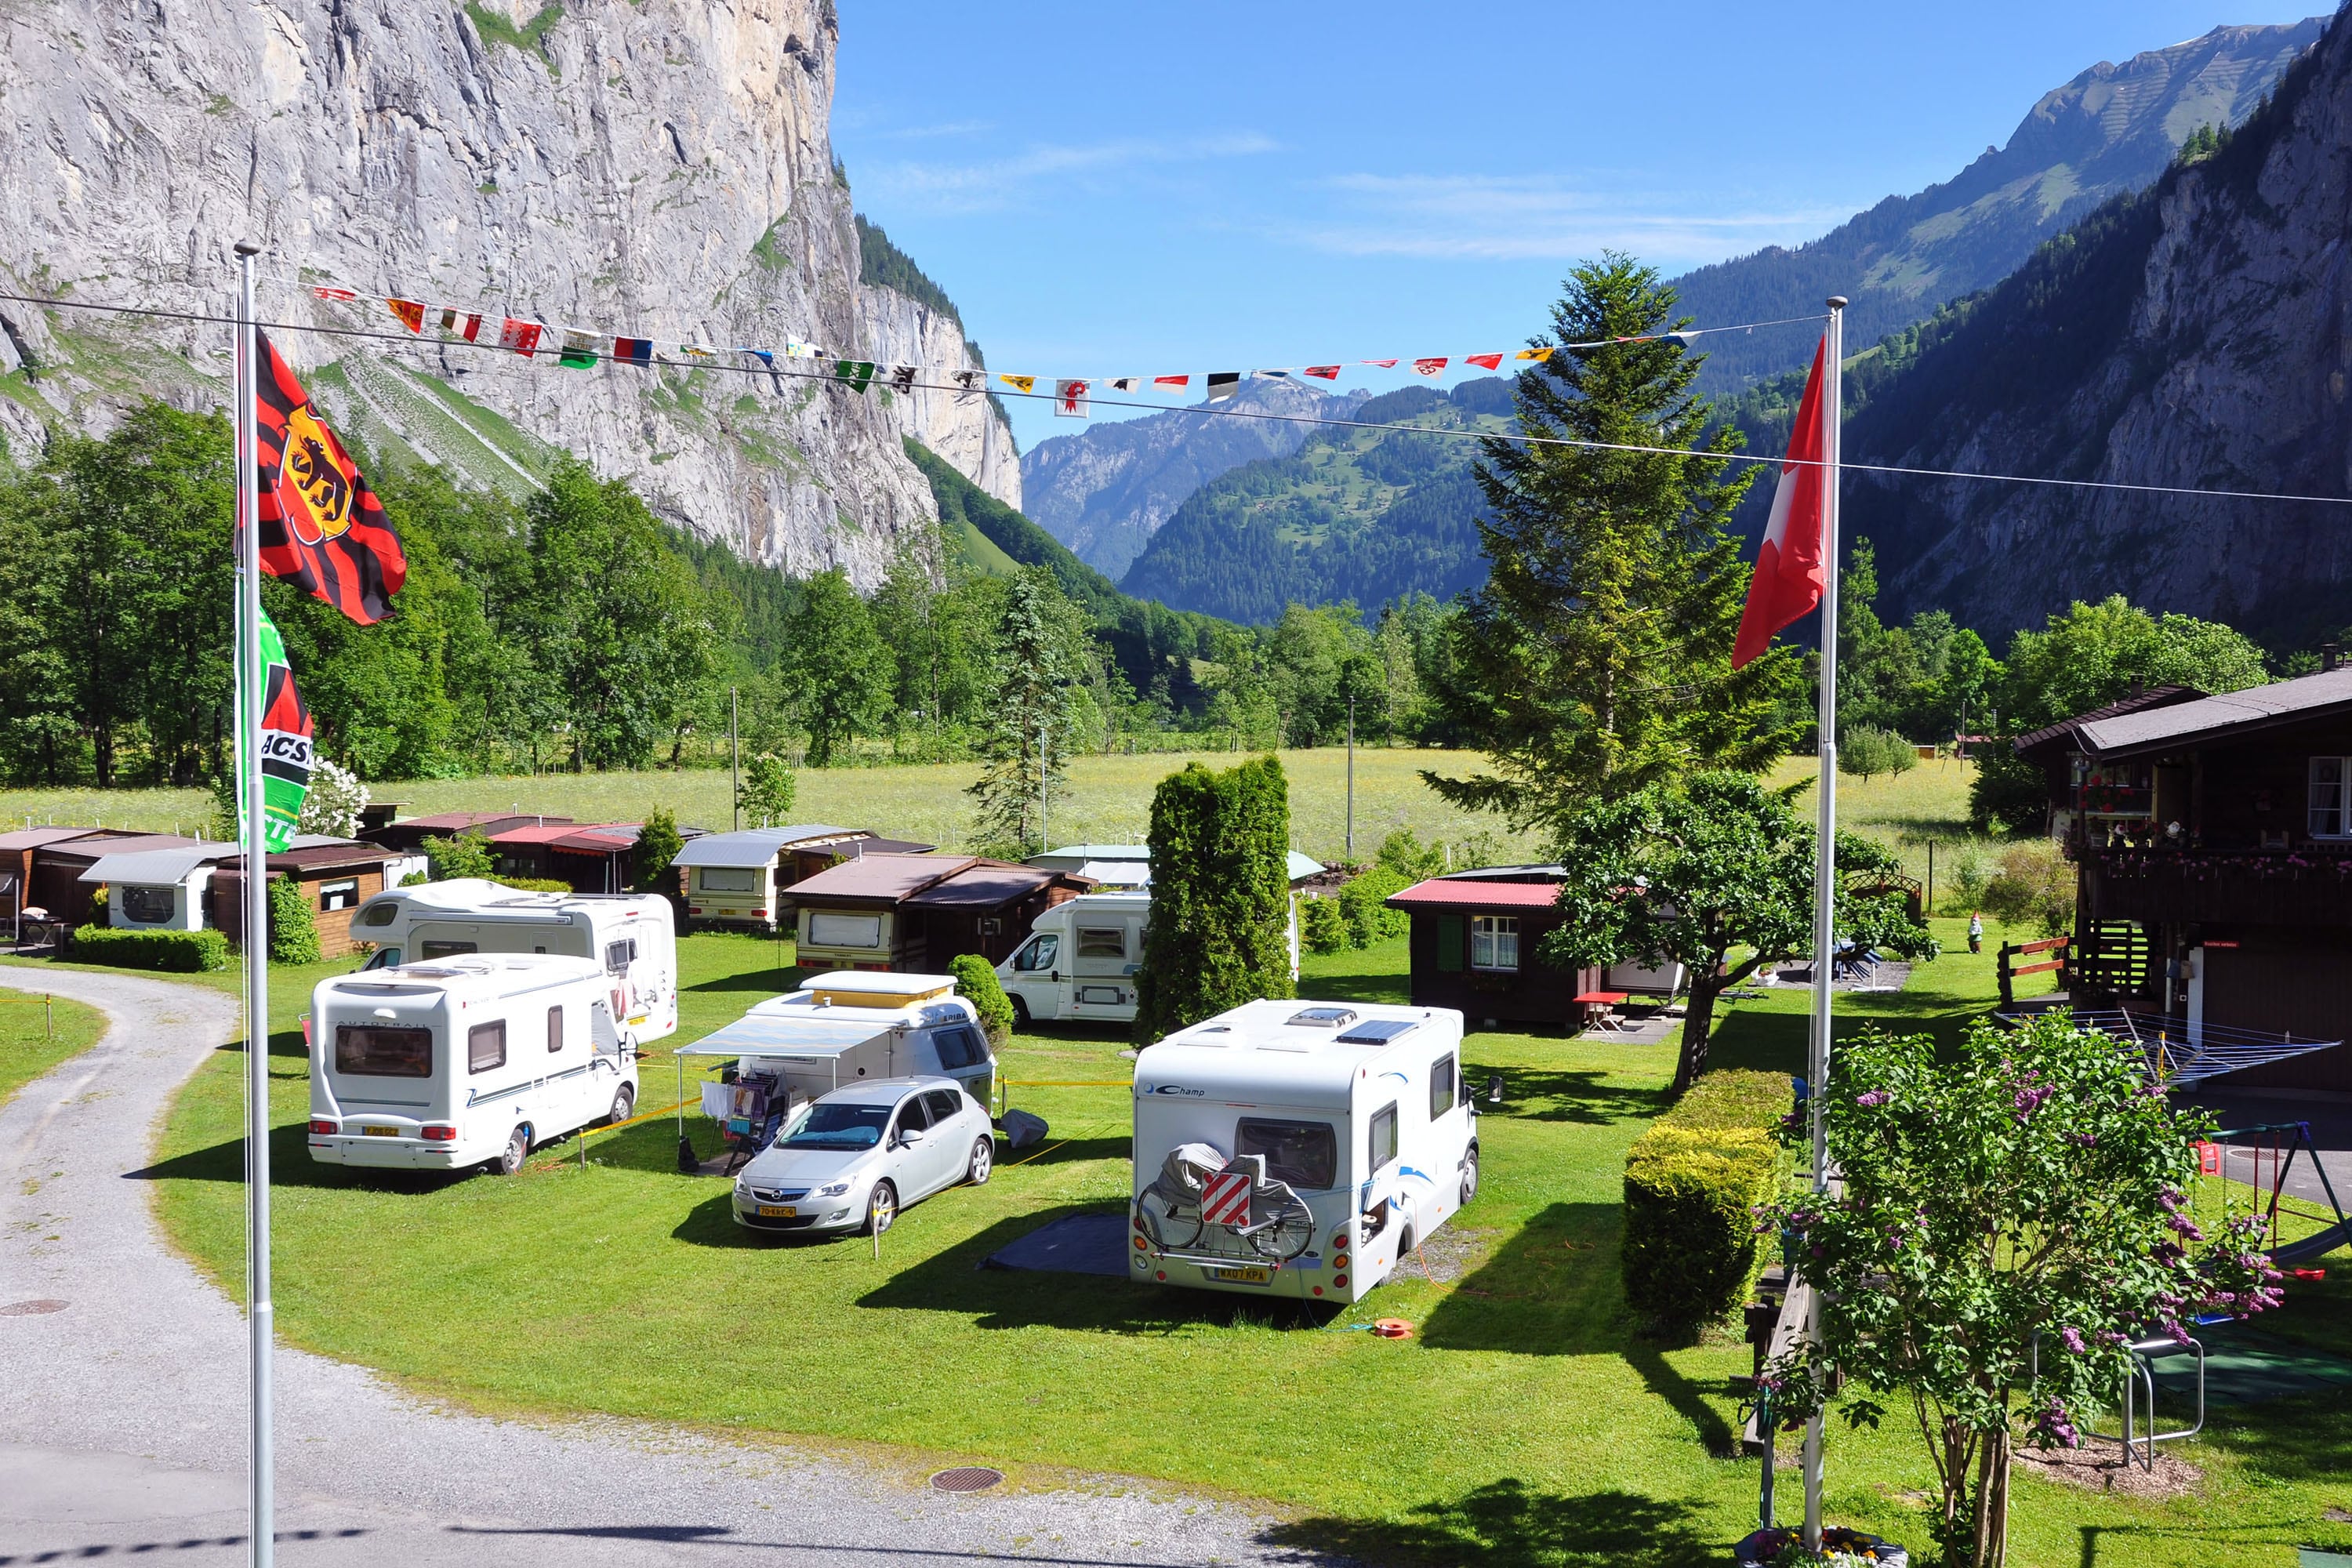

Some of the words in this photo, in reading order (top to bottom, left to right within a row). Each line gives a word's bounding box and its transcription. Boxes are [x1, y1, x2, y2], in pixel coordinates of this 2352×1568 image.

[568, 340, 593, 350] PATRIE
[943, 1012, 967, 1022] ERIBA
[1155, 1085, 1205, 1098] Champ
[1245, 1269, 1265, 1280] KPA
